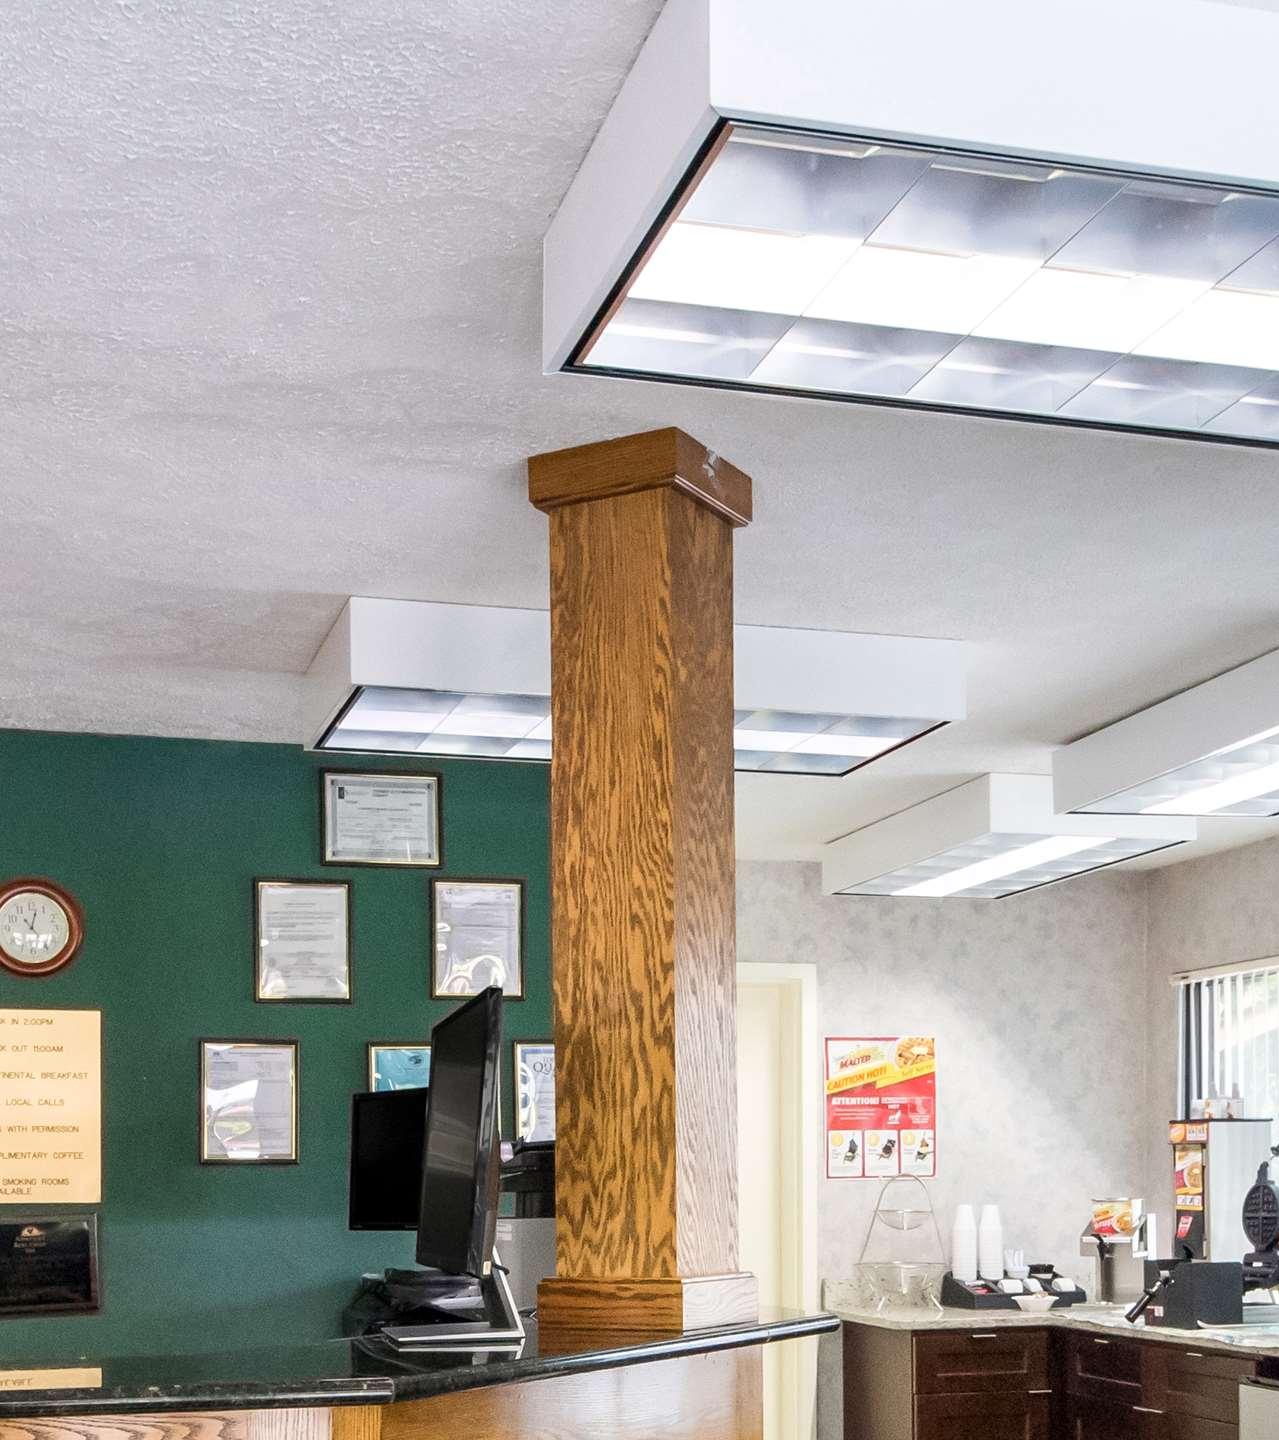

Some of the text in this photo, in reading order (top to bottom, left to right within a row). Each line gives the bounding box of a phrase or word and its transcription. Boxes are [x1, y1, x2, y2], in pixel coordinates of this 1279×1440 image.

[11, 1018, 20, 1026] IN
[41, 1072, 89, 1080] BREAKFAST
[827, 1072, 865, 1091] CAUTION
[6, 1098, 32, 1106] LOCAL
[37, 1098, 65, 1107] CALLS
[7, 1125, 28, 1134] WITH
[32, 1125, 80, 1134] PERMISSION
[53, 1152, 84, 1160] COFFEE
[2, 1178, 37, 1186] SMOKING
[41, 1178, 70, 1186] ROOMS
